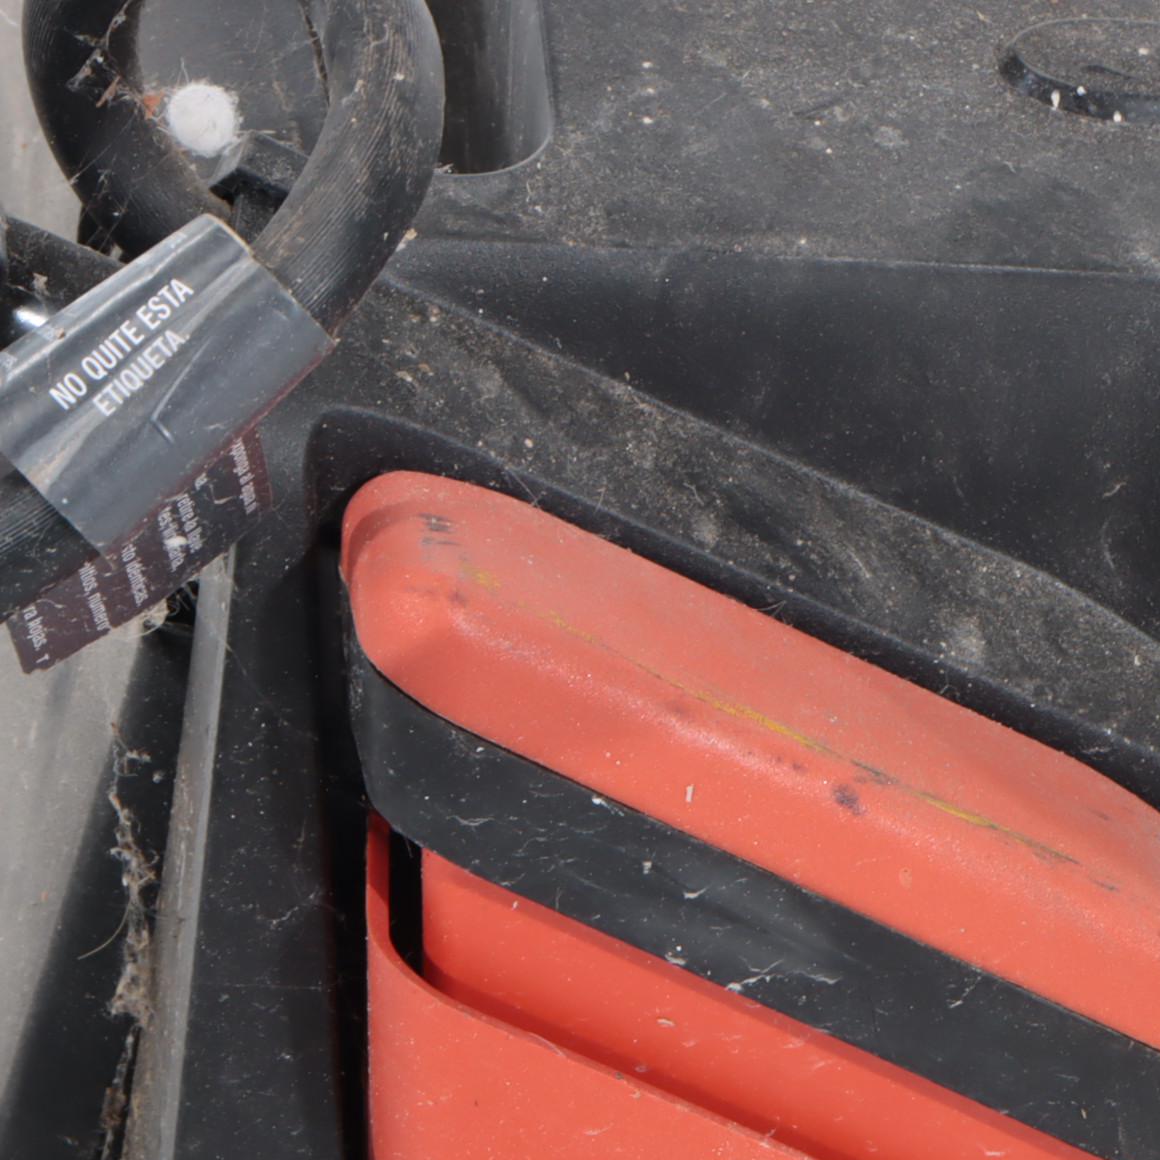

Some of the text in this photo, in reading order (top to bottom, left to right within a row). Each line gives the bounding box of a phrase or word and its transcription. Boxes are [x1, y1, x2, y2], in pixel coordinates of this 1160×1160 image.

[49, 279, 194, 410] NO QUITE ESTA
[93, 330, 190, 416] ETIQUETA.
